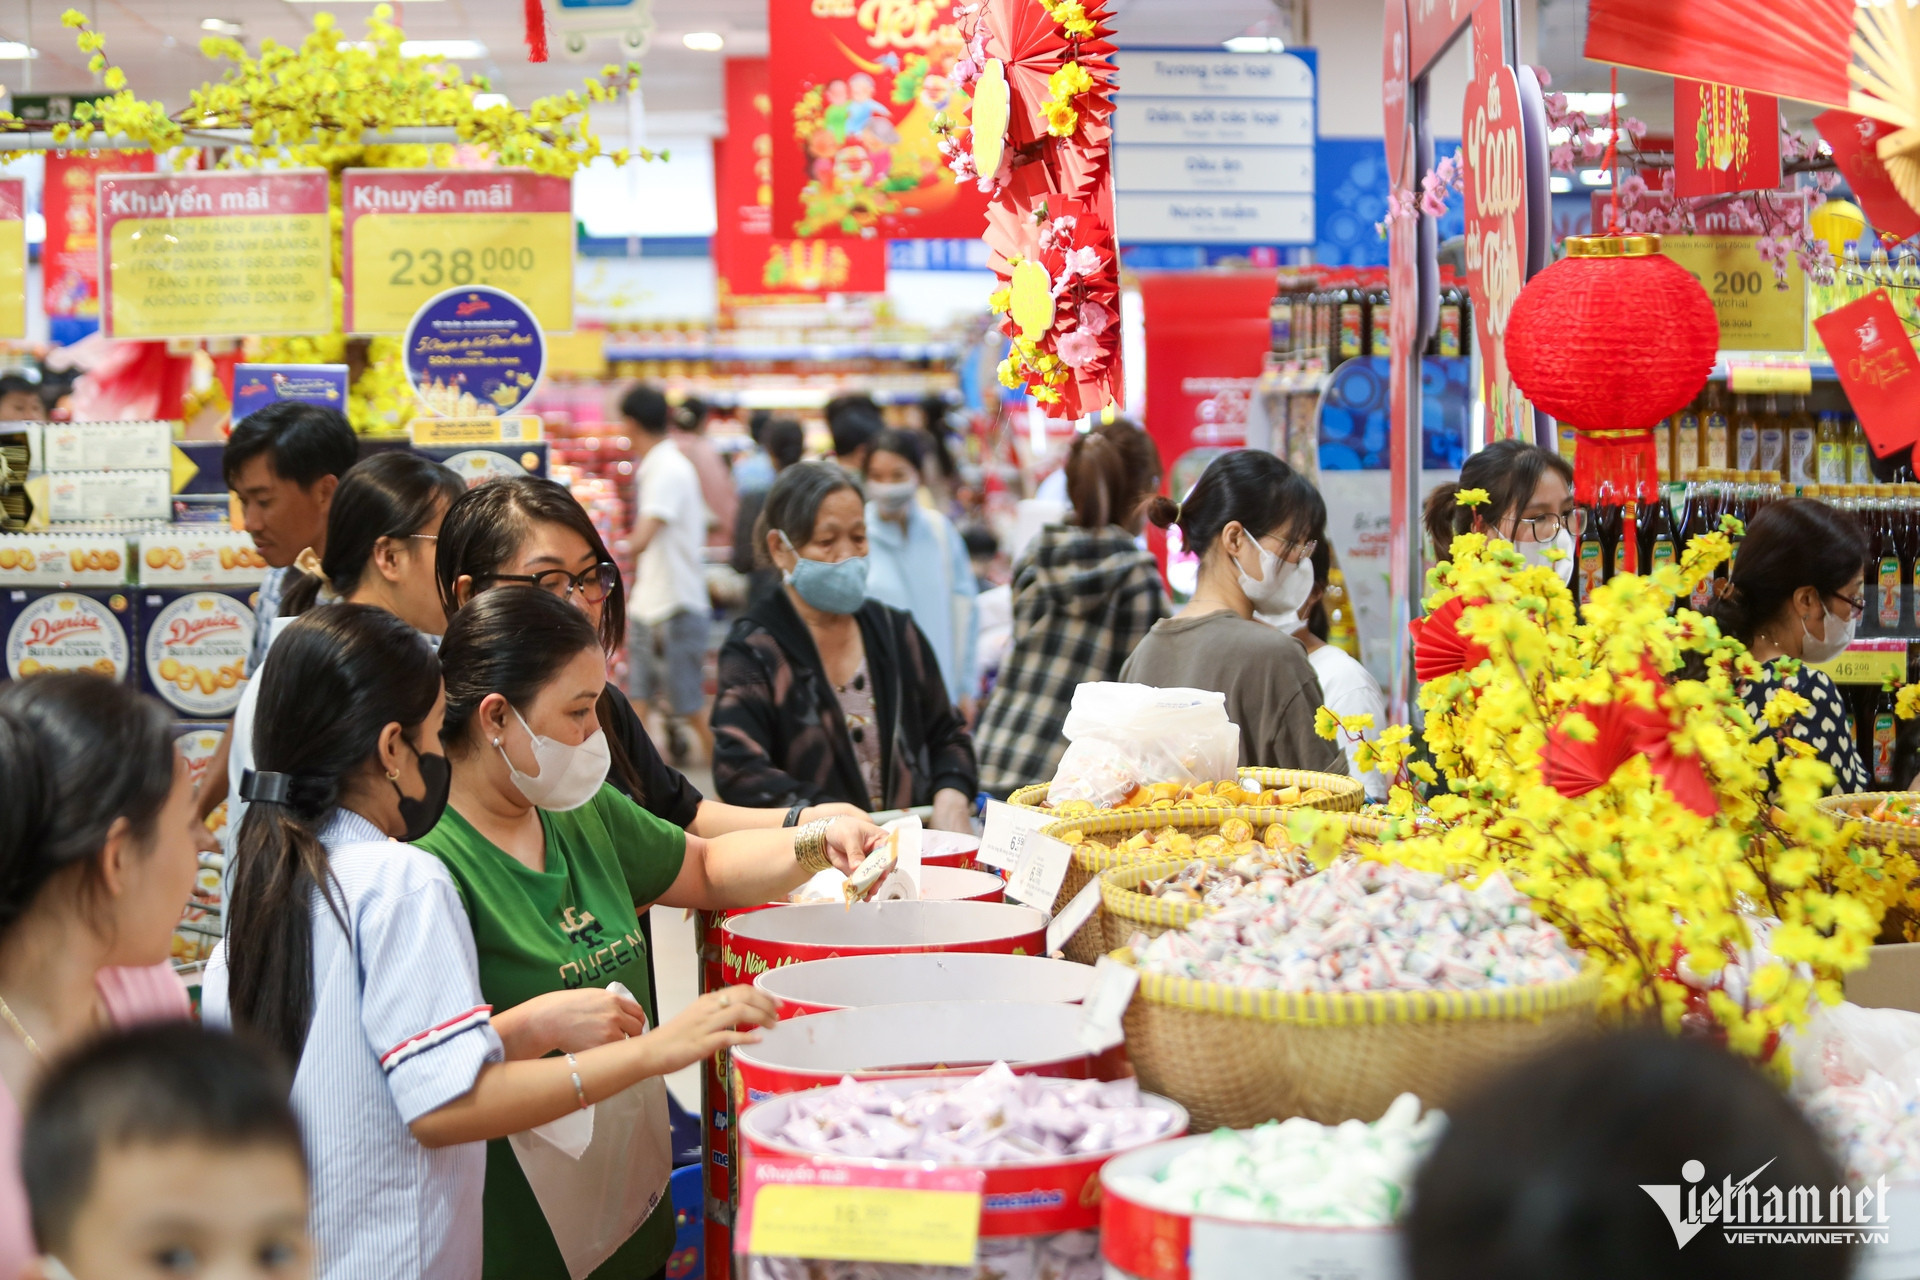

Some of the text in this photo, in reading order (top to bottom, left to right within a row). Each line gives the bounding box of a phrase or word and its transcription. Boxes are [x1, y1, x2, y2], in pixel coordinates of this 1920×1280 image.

[110, 185, 269, 217] Khuyến mãi
[353, 181, 512, 212] Khuyến mãi
[24, 611, 101, 646] Danisa
[164, 611, 241, 646] Danisa
[558, 929, 647, 990] QUEEN
